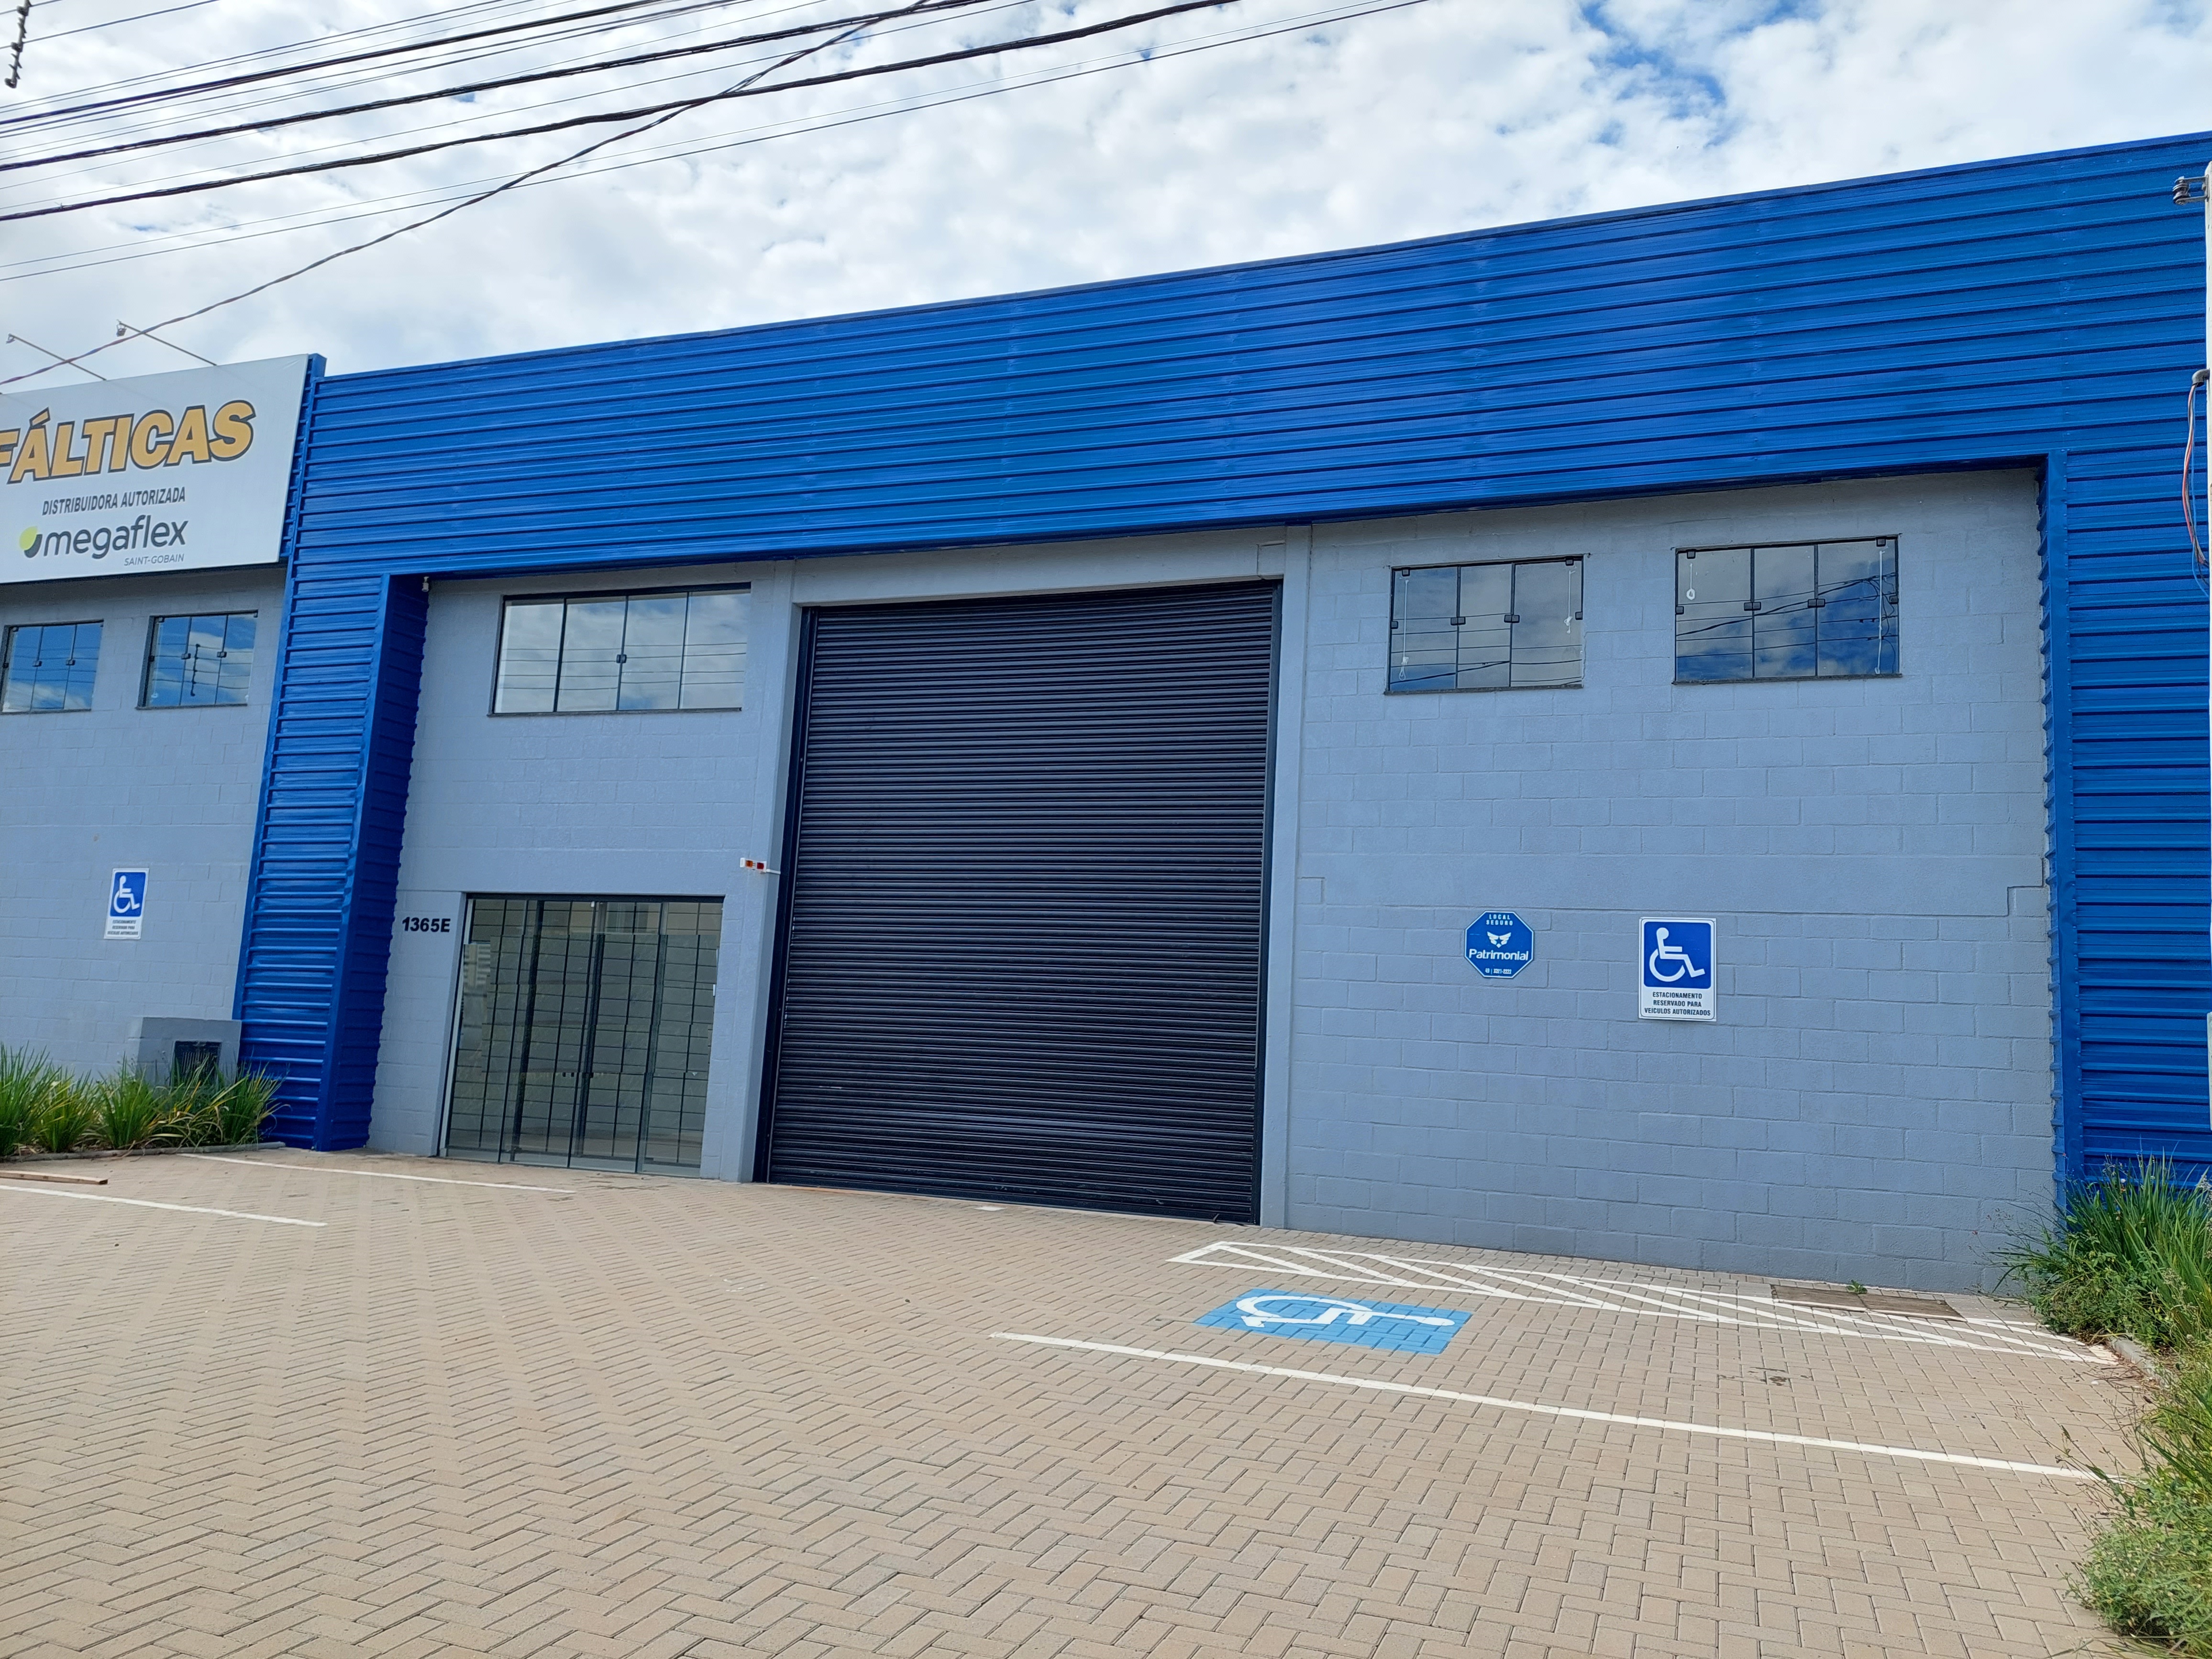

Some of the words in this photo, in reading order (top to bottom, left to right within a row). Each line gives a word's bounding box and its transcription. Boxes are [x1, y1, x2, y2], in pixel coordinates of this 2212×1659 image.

[42, 493, 118, 516] DISTRIBUIDORA
[121, 487, 186, 507] AUTORIZADA
[43, 514, 188, 559] megaflex
[124, 553, 184, 566] SAINT-GOBAIN
[402, 917, 451, 932] 1365E
[1469, 949, 1529, 961] Patrimonial
